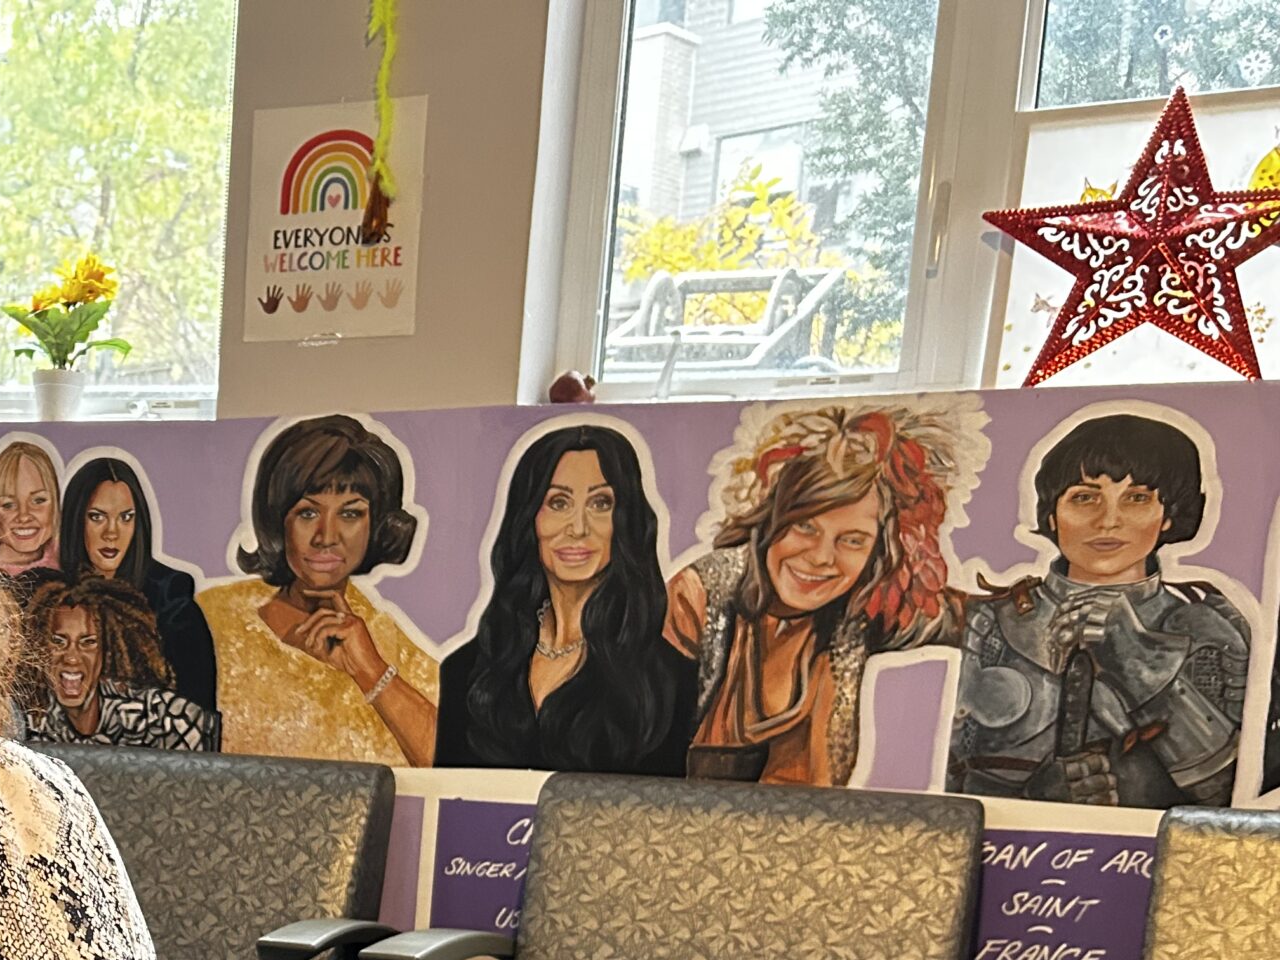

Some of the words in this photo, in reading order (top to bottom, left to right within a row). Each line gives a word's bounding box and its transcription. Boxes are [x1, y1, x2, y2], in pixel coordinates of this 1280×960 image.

[273, 225, 367, 250] EVERYON
[263, 250, 349, 273] WELCOME
[355, 246, 402, 268] HERE
[1051, 849, 1094, 870] OF
[1001, 891, 1101, 922] SAINT
